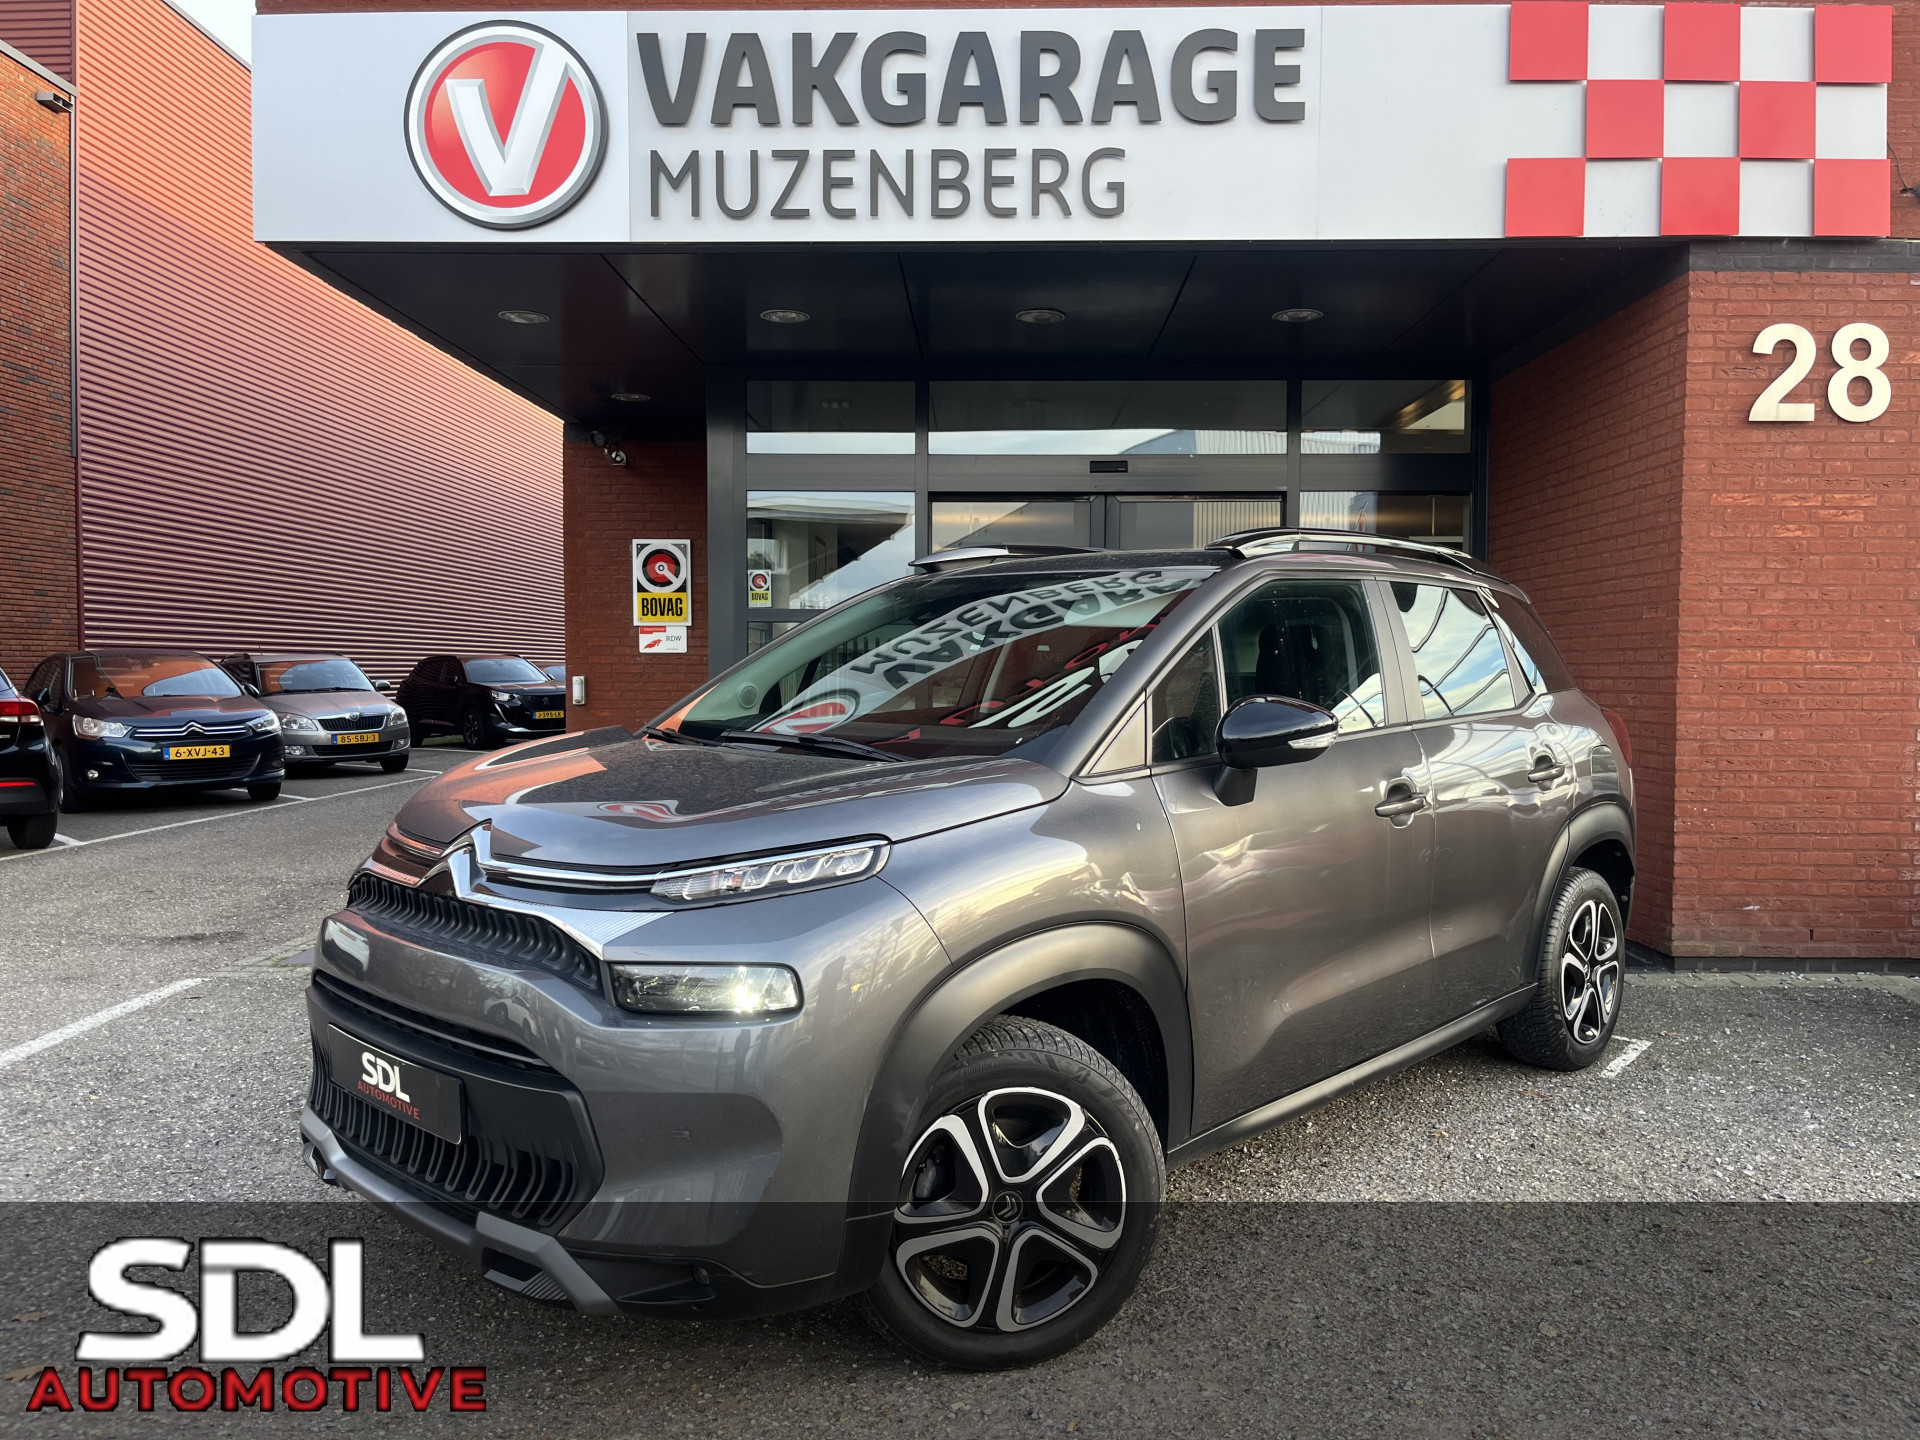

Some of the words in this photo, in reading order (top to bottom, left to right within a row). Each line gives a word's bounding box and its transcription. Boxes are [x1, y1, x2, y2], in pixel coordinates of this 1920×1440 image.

[636, 28, 1306, 128] VAKGARAGE
[650, 147, 1126, 220] MUZENBERG
[1748, 322, 1892, 423] 28
[641, 597, 684, 617] BOVAG
[751, 592, 769, 600] BOVAG
[174, 747, 225, 758] 6-XVJ-43
[341, 734, 376, 744] 85-SBJ-3
[361, 1051, 411, 1103] SDL
[357, 1080, 420, 1120] AUTOMOTIVE
